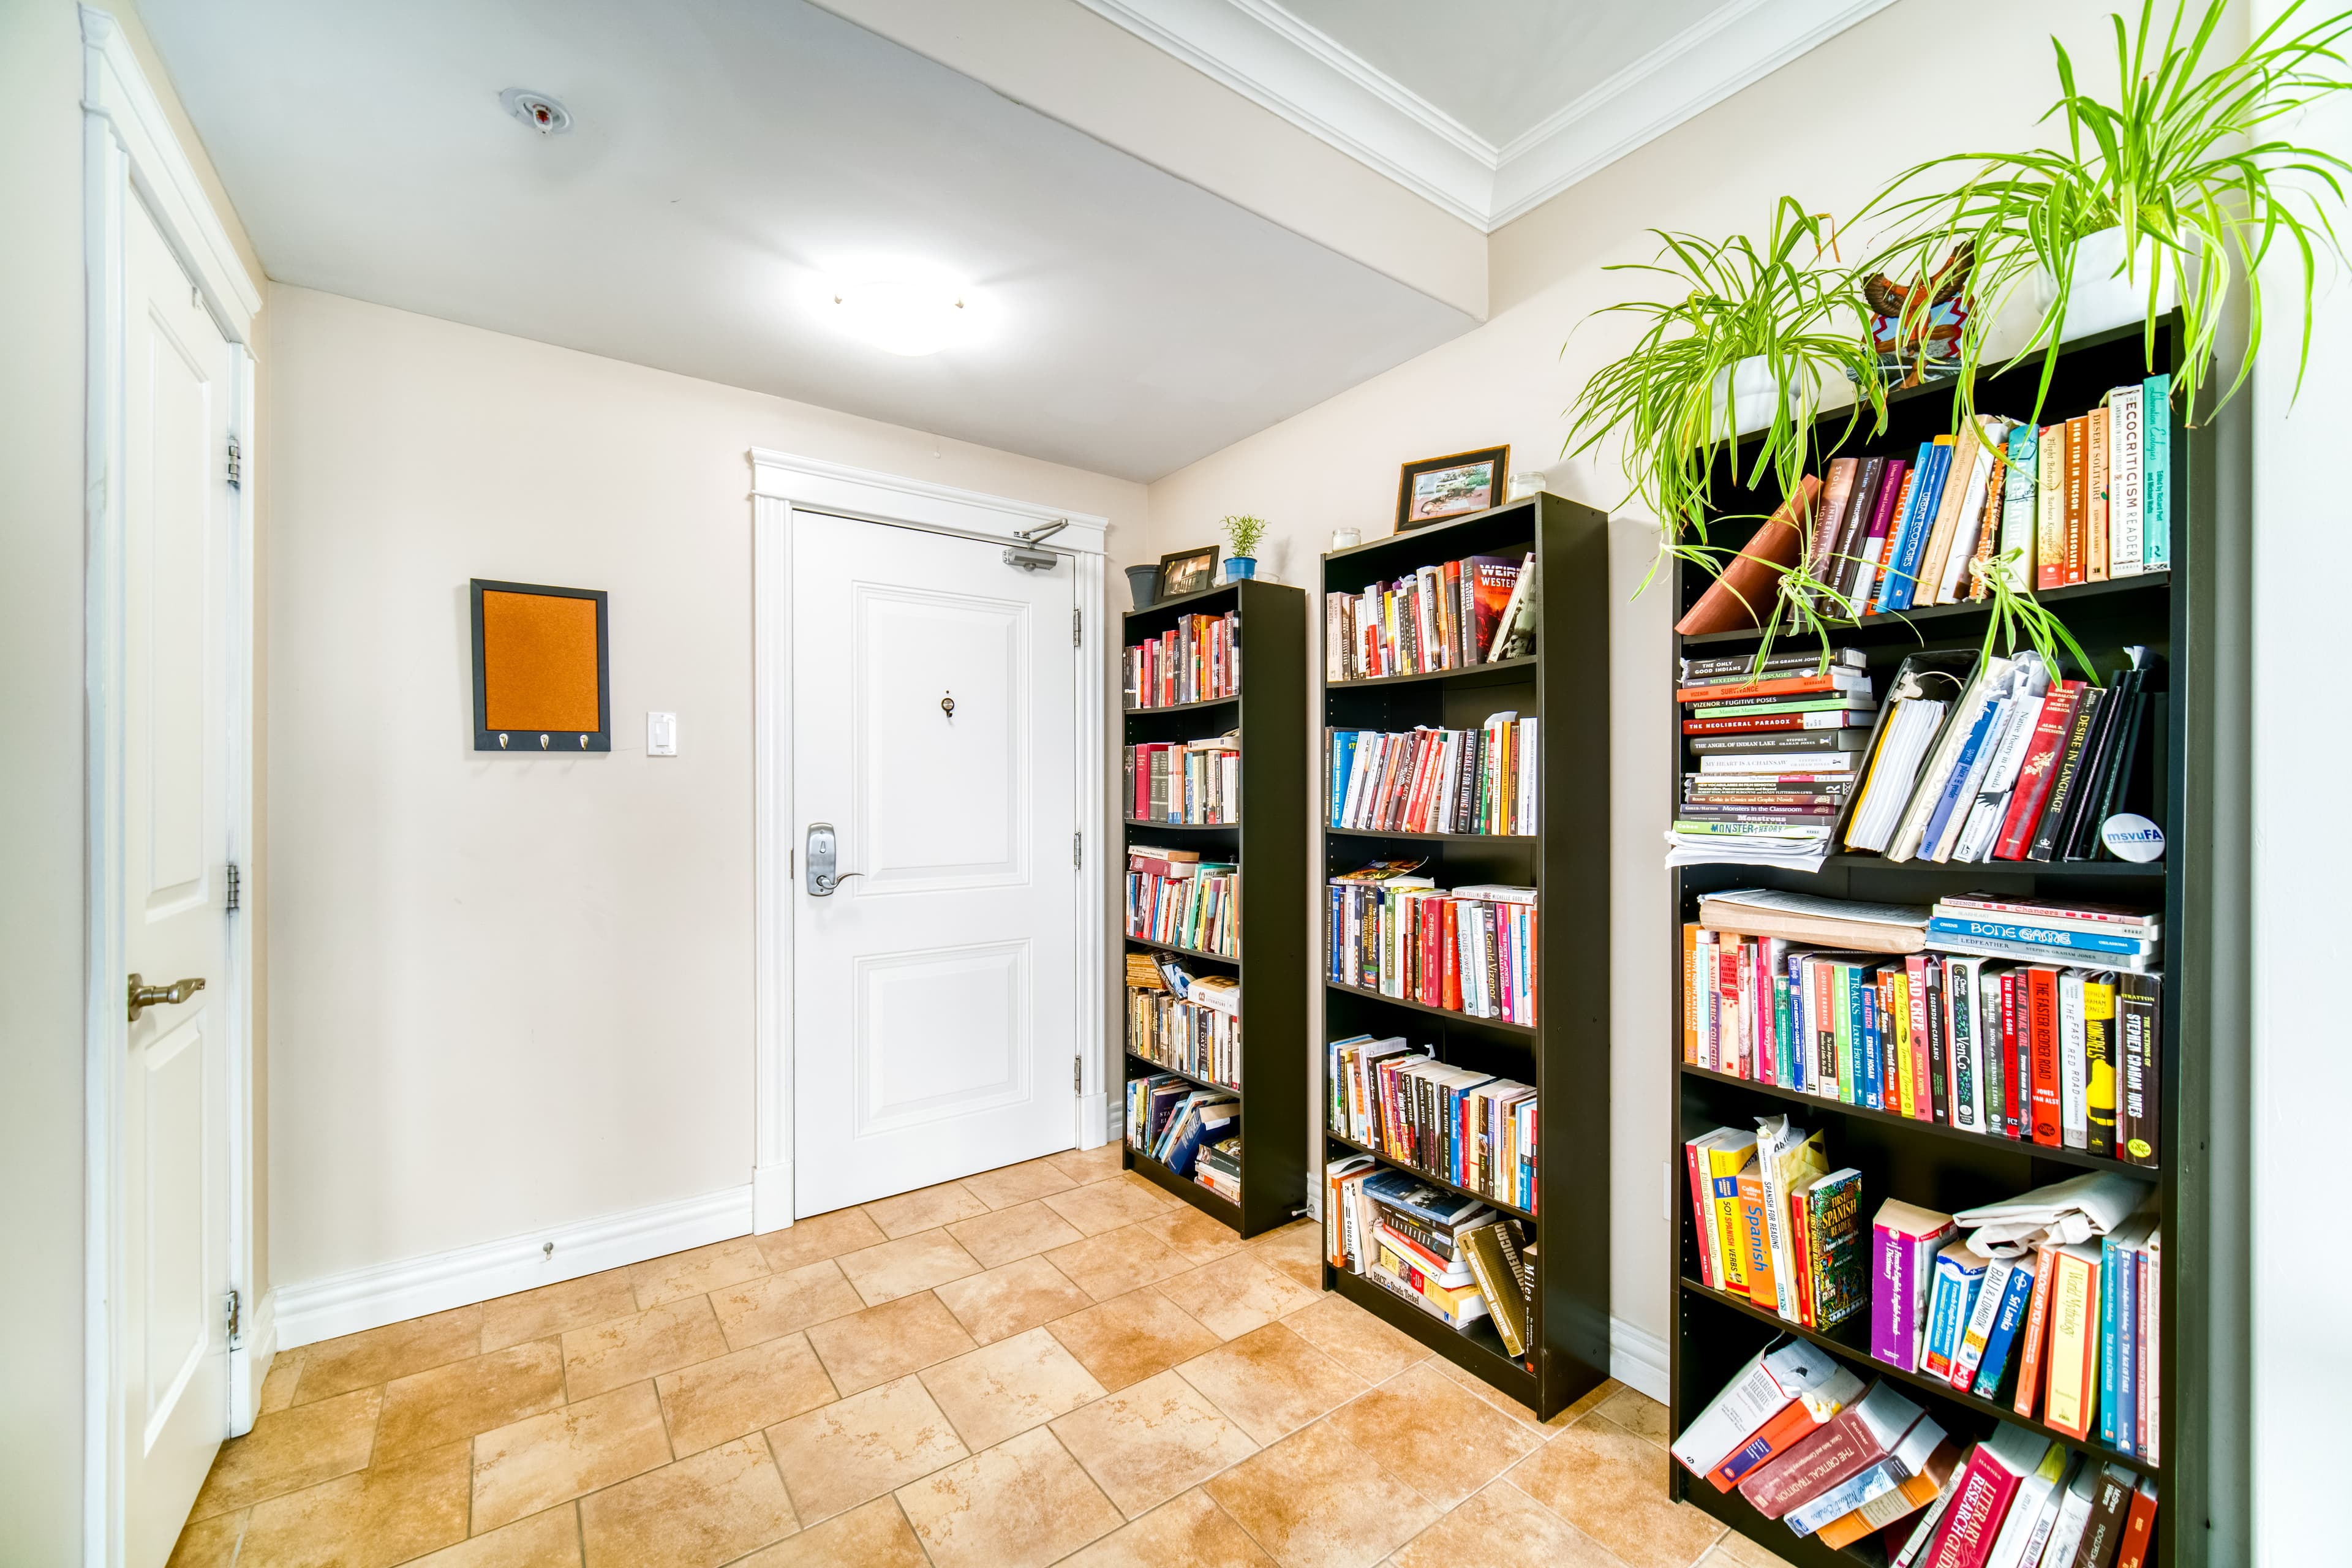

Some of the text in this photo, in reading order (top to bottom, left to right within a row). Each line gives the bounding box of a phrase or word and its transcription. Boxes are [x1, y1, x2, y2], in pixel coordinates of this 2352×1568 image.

[2044, 437, 2056, 492] Flight Behavior
[2072, 446, 2081, 464] TIDE
[1830, 466, 1842, 491] STOLL
[2072, 467, 2080, 477] IN
[2126, 402, 2137, 557] ECOCRITICISM READER
[2071, 480, 2080, 510] TUCSON
[1817, 506, 1826, 527] HOLY
[1903, 492, 1931, 567] URBAN ECOLOGIES
[2069, 519, 2079, 568] KINGSOLVER
[1464, 731, 1474, 771] REHEARSALS
[2050, 715, 2090, 813] DESIRE IN LANGUAGE
[1406, 761, 1414, 783] NATIVE
[1460, 787, 1469, 808] LIVING
[2107, 829, 2163, 842] msvuFA
[2015, 906, 2059, 916] Chancers
[1961, 937, 2010, 949] LEDFEATHER
[1970, 922, 2016, 938] BONE
[2019, 927, 2072, 945] GAME
[1486, 933, 1498, 1000] Gerald Vizenor
[1909, 971, 1922, 996] BAD
[1911, 1000, 1924, 1031] CREE
[2019, 1008, 2027, 1030] FINAL
[2035, 982, 2051, 1079] THE FASTER REDDER ROAD
[1956, 1036, 1970, 1070] VenCo
[2019, 1031, 2027, 1047] GIRL
[2127, 1013, 2143, 1118] STEPHEN GRAHAM JONES
[1741, 1185, 1762, 1194] Collins
[1764, 1182, 1779, 1250] SPANISH FOR READING
[1822, 1199, 1856, 1229] SPANISH
[1723, 1200, 1738, 1272] 501 SPANISH VERBS
[1745, 1205, 1768, 1272] Spanish
[1373, 1271, 1387, 1287] RACE
[1390, 1282, 1420, 1305] Studs Terkel
[1524, 1262, 1534, 1302] Miles
[1987, 1267, 2004, 1291] BALI
[2032, 1251, 2050, 1325] MYTHOLOGY AND YOU
[1975, 1297, 1994, 1329] LOMBOK
[2000, 1294, 2021, 1332] Sri Lanka
[1850, 1420, 1869, 1446] Richter
[1775, 1446, 1855, 1504] THE CRITICAL TRADITION
[1978, 1458, 2002, 1481] HARNER
[1935, 1471, 1985, 1568] RESEARCH GUID
[1964, 1481, 1997, 1548] LITERARY
